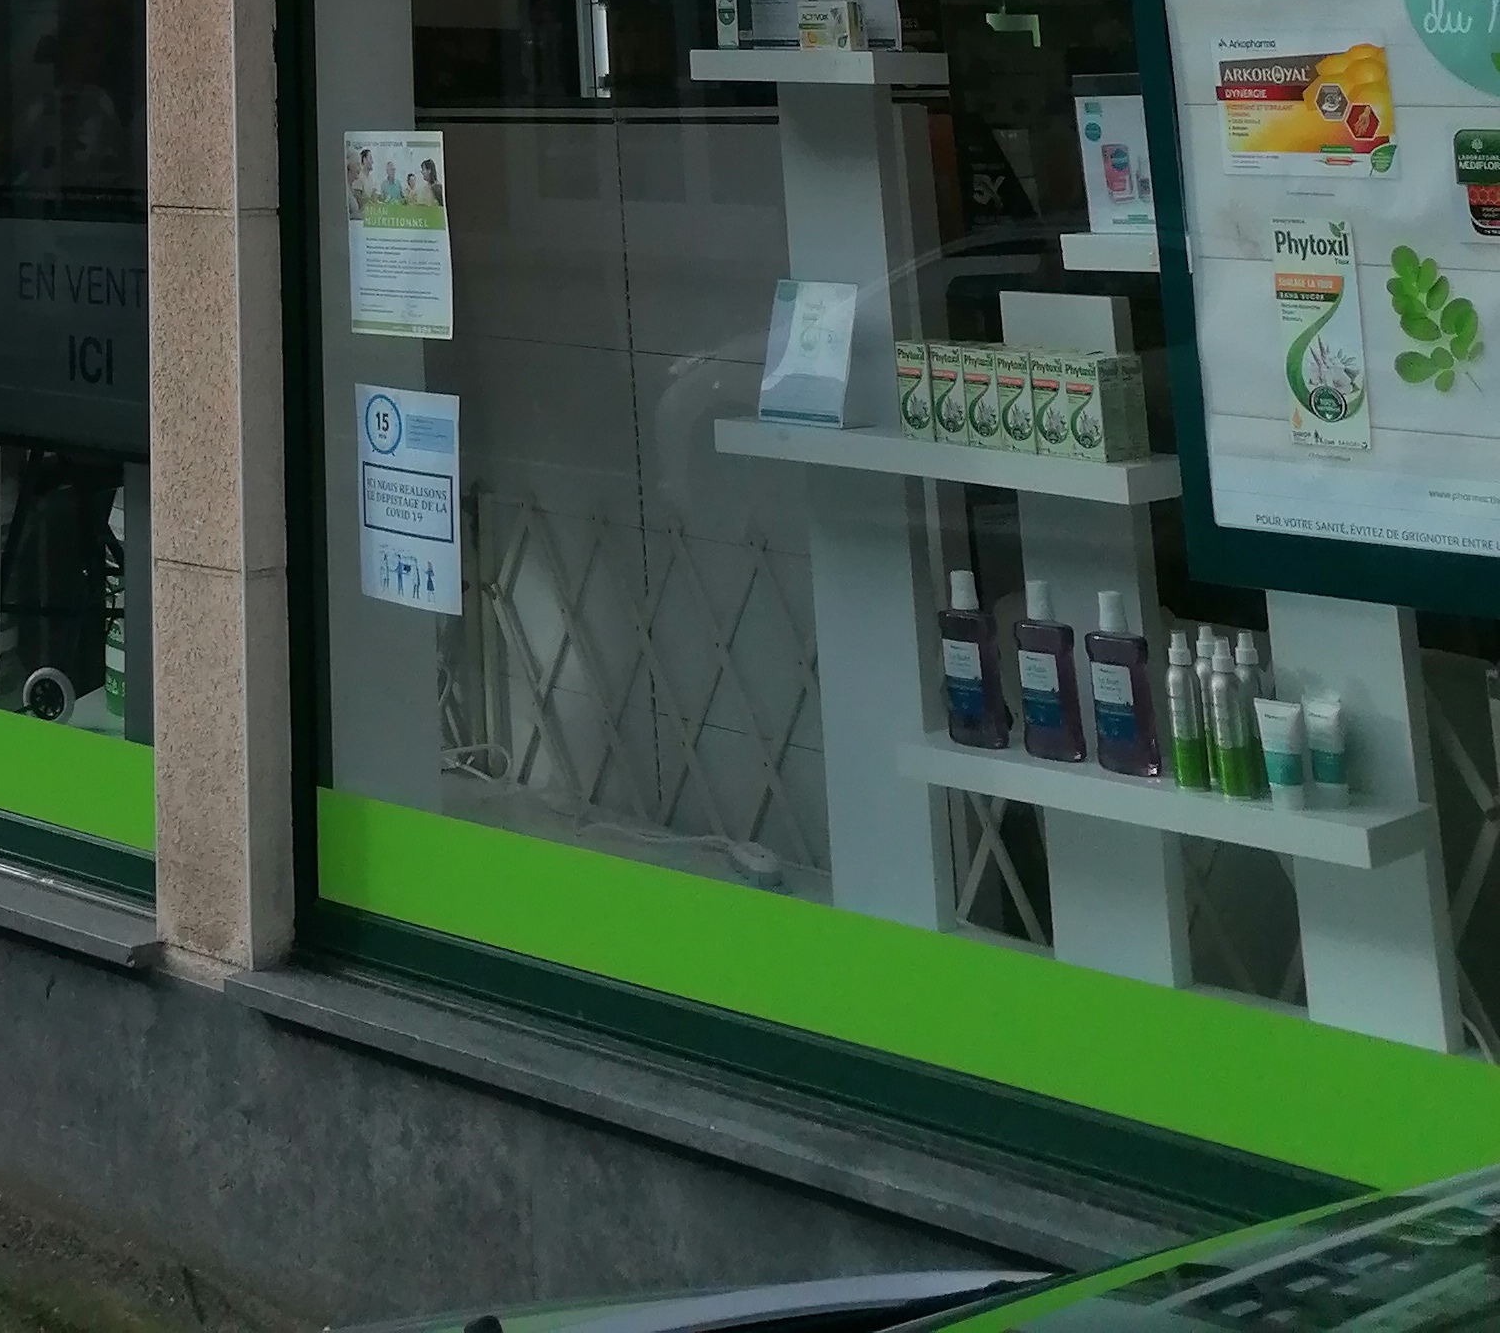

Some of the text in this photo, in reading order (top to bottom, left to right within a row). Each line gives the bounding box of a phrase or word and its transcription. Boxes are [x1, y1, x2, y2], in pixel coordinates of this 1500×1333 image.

[1223, 65, 1309, 84] ARKOROYAL
[1274, 229, 1349, 261] Phytoxil
[18, 261, 56, 302] EN
[68, 333, 114, 386] ICI
[375, 411, 389, 432] 15
[377, 480, 398, 493] NOUS
[385, 506, 423, 523] COVID 19
[421, 500, 433, 511] DE
[435, 502, 448, 514] LA
[1256, 513, 1282, 526] POUR
[1283, 517, 1313, 530] VOTRE
[1386, 528, 1399, 540] DE
[1402, 530, 1461, 547] GRIGNOTER
[1462, 536, 1493, 551] ENTRE
